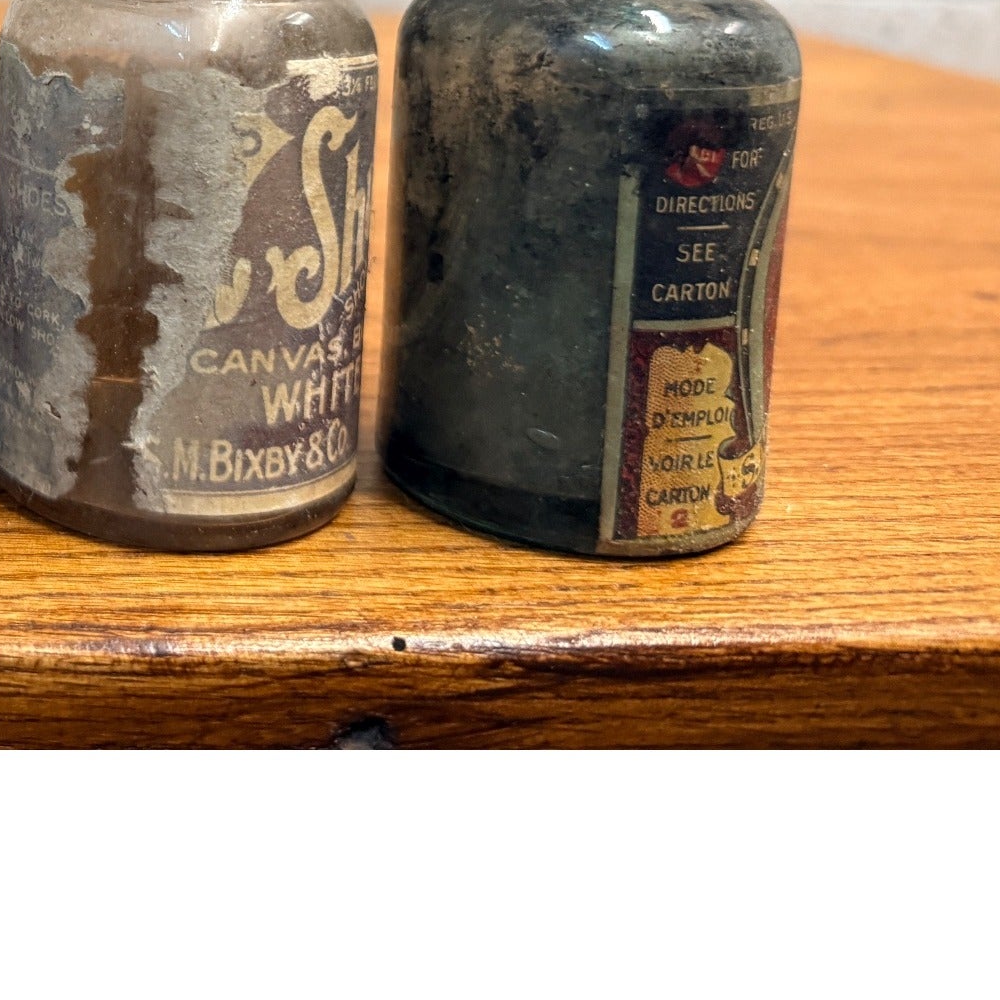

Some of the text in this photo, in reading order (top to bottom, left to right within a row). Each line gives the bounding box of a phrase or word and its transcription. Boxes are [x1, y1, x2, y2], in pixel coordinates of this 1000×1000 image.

[732, 150, 758, 170] FOR
[655, 191, 755, 215] DIRECTIONS
[675, 242, 717, 264] SEE
[651, 280, 730, 303] CARTON
[664, 378, 717, 398] MODE
[651, 405, 730, 431] D'EMPLOI
[697, 450, 715, 471] LE
[645, 484, 711, 507] CARTON
